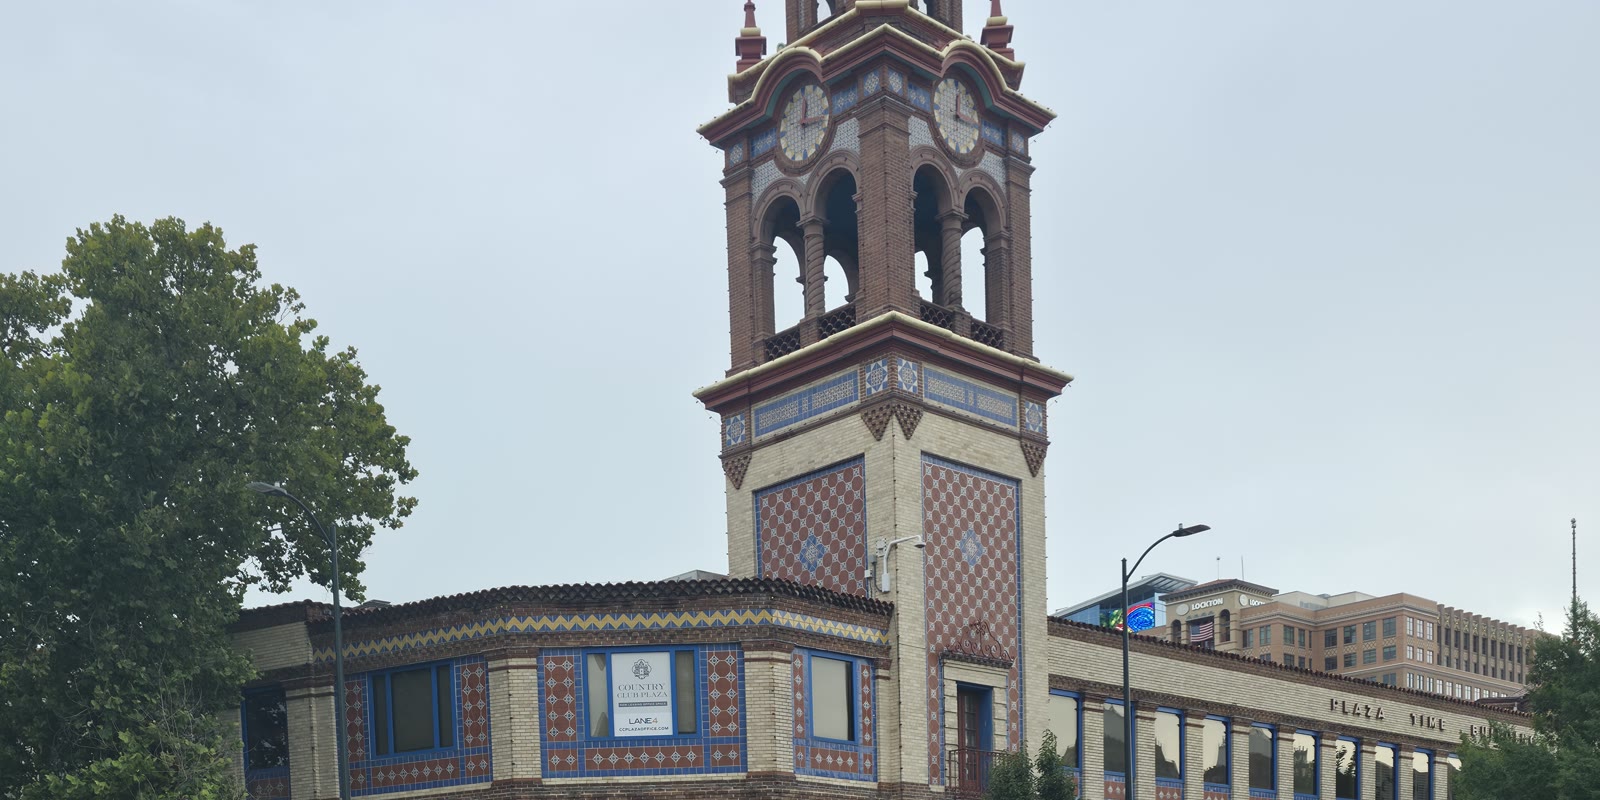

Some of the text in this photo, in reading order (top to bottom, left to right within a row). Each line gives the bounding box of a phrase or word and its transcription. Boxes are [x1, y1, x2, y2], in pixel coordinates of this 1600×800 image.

[1192, 598, 1223, 610] LOCKTON
[1330, 698, 1385, 719] PLAZA
[1410, 713, 1446, 731] TIME
